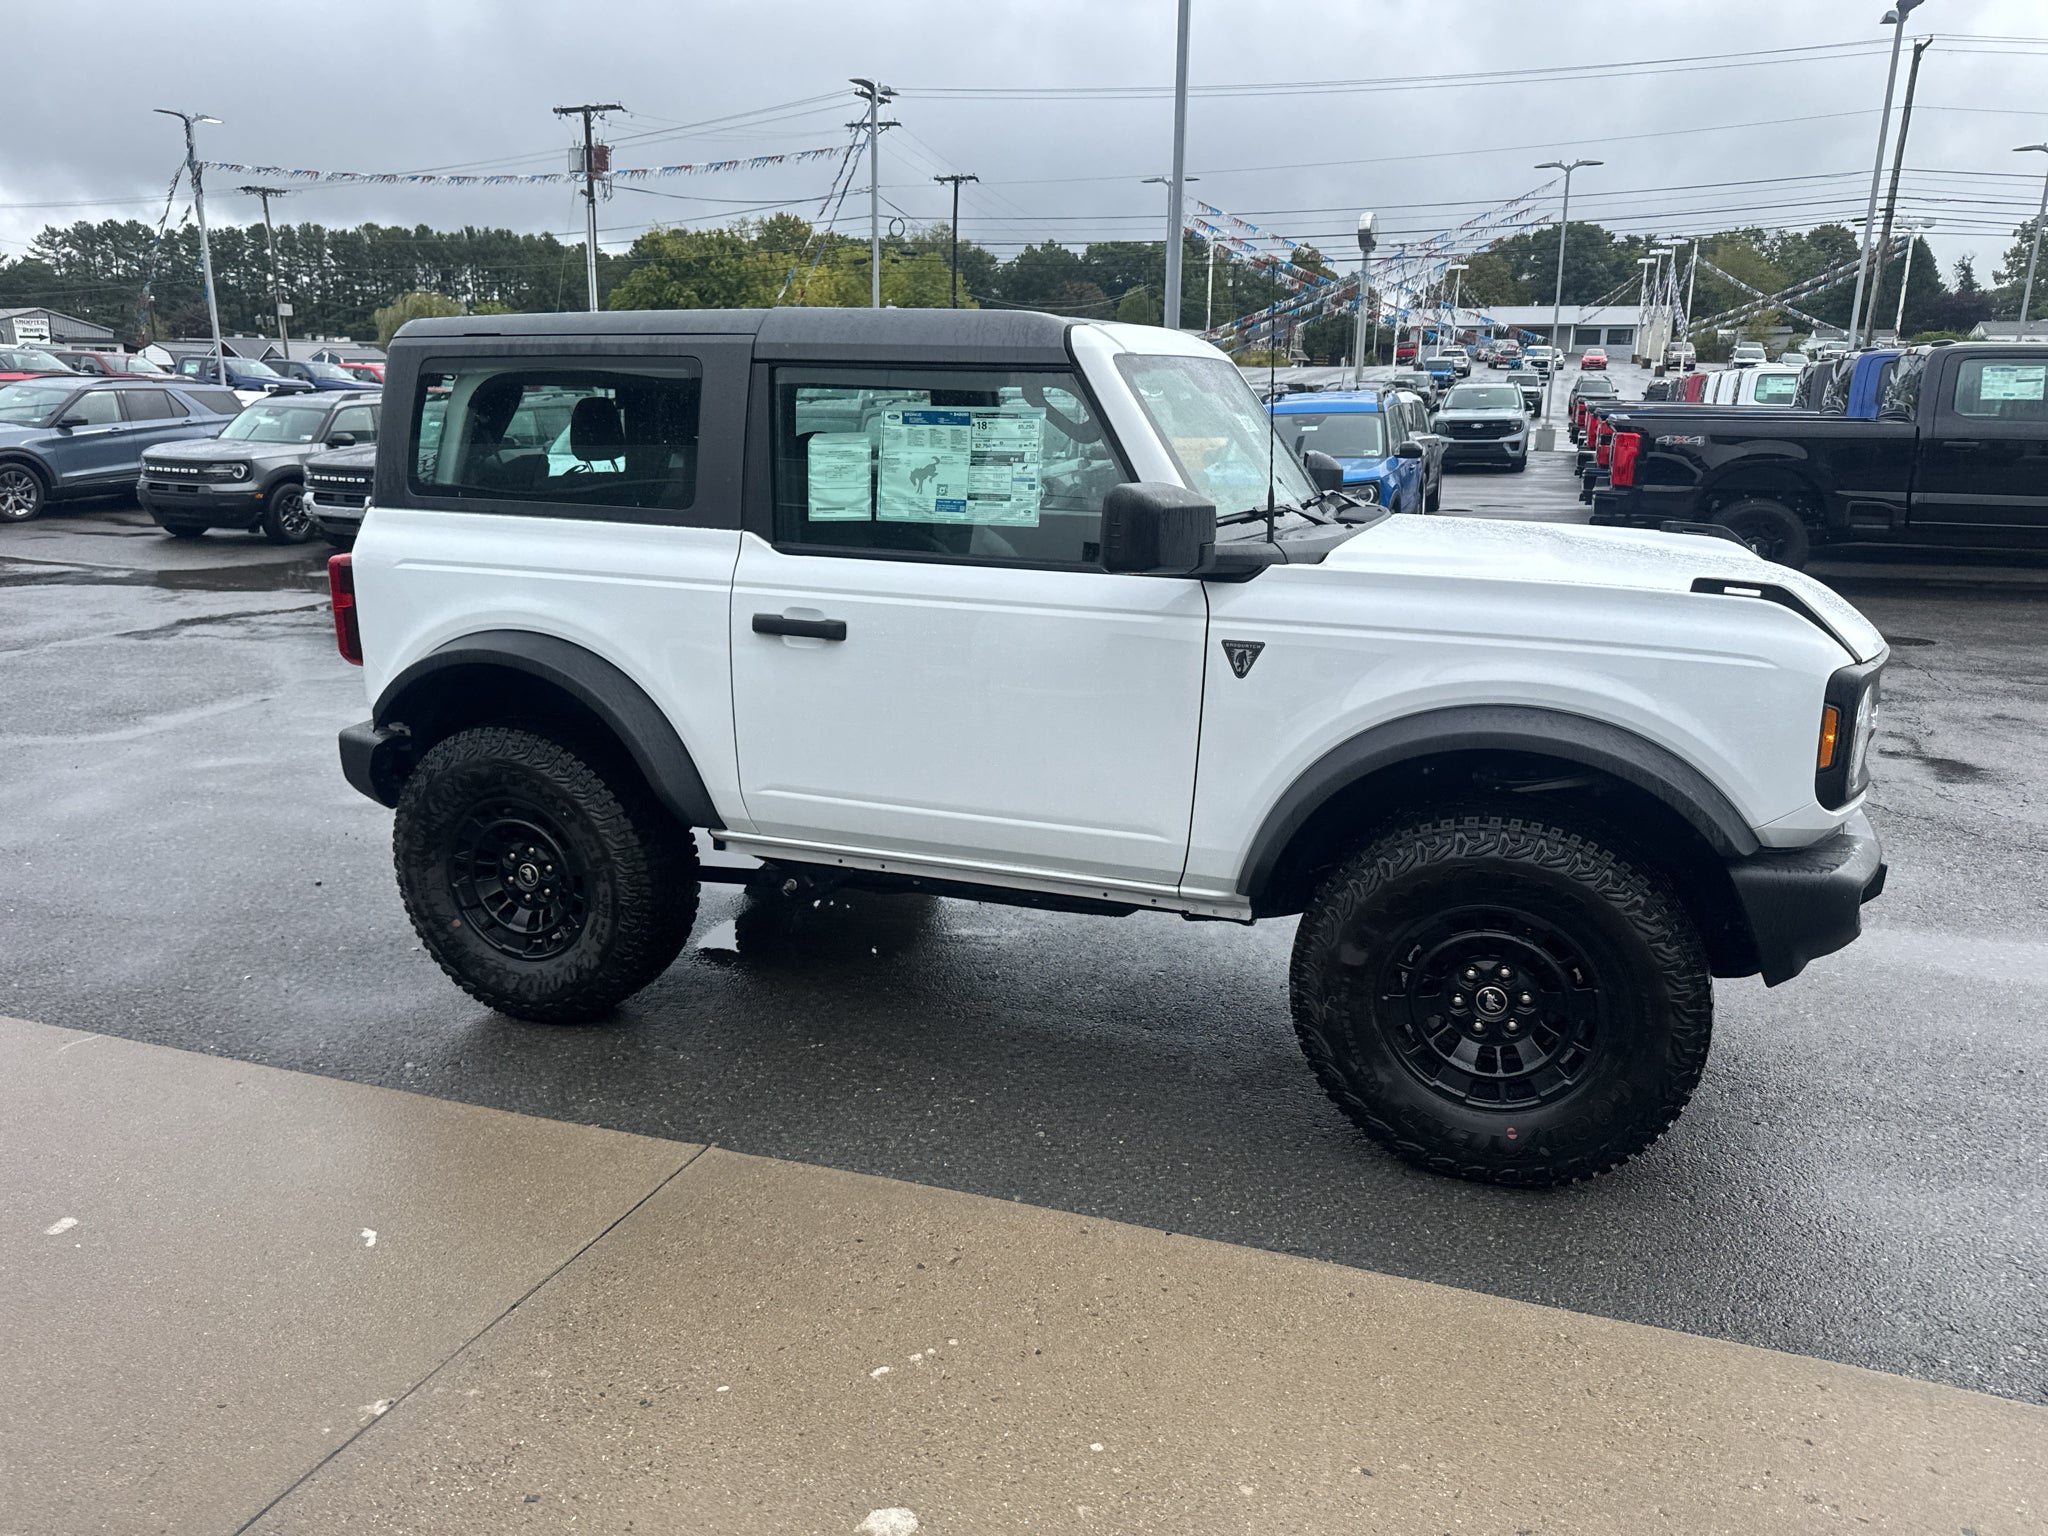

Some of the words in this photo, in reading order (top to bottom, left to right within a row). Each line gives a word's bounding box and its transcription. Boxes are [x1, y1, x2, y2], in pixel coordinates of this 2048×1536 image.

[976, 421, 988, 430] 18
[148, 466, 199, 474] BRONCO
[313, 475, 366, 483] BRONCO
